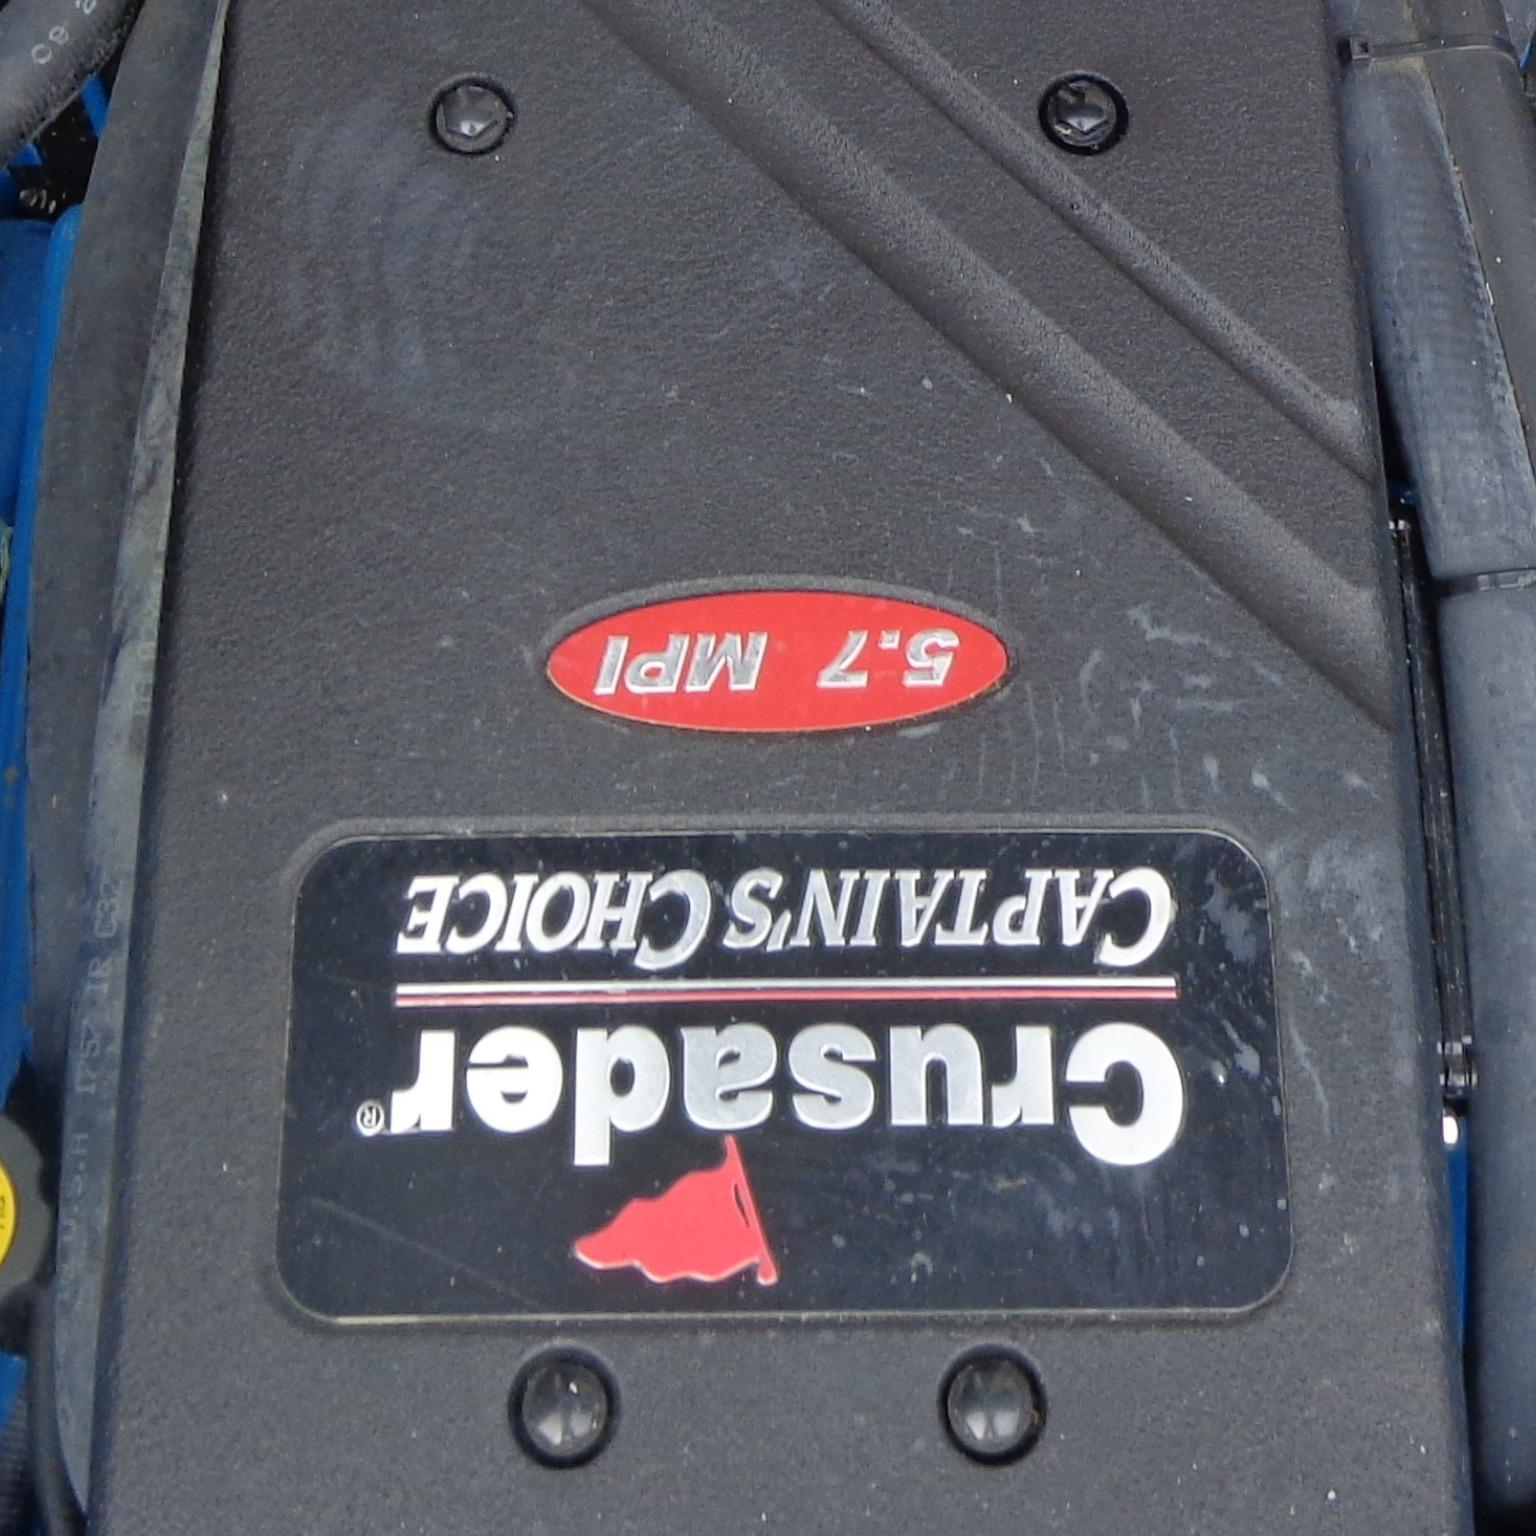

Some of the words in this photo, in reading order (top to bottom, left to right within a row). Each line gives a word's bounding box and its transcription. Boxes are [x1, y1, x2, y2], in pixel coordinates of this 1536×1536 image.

[31, 25, 70, 65] 08
[595, 632, 769, 696] MPI
[817, 629, 959, 688] 5.7
[396, 869, 710, 969] CHOICE
[723, 867, 1175, 968] CAPTAIN'S
